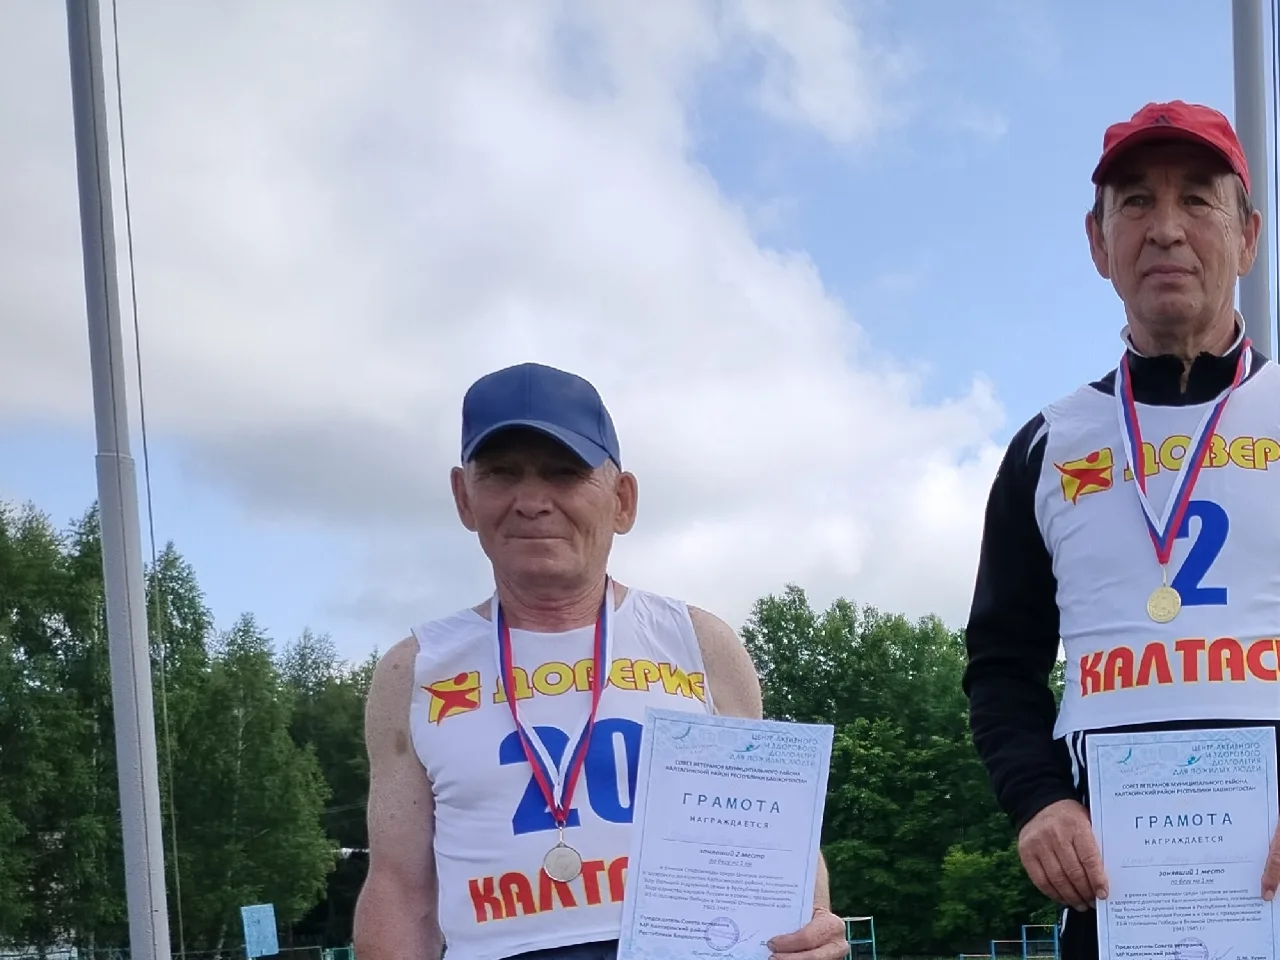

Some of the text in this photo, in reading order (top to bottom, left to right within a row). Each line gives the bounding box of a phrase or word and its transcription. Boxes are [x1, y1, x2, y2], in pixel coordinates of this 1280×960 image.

[1170, 500, 1230, 606] 2
[499, 718, 644, 836] 20
[682, 792, 780, 814] ГРАМОТА
[690, 816, 769, 829] НАГРАЖДАЕТСЯ
[1135, 812, 1233, 829] ГРАМОТА
[1144, 835, 1224, 846] НАГРАЖДАЕТСЯ
[468, 856, 629, 923] КАЛТ
